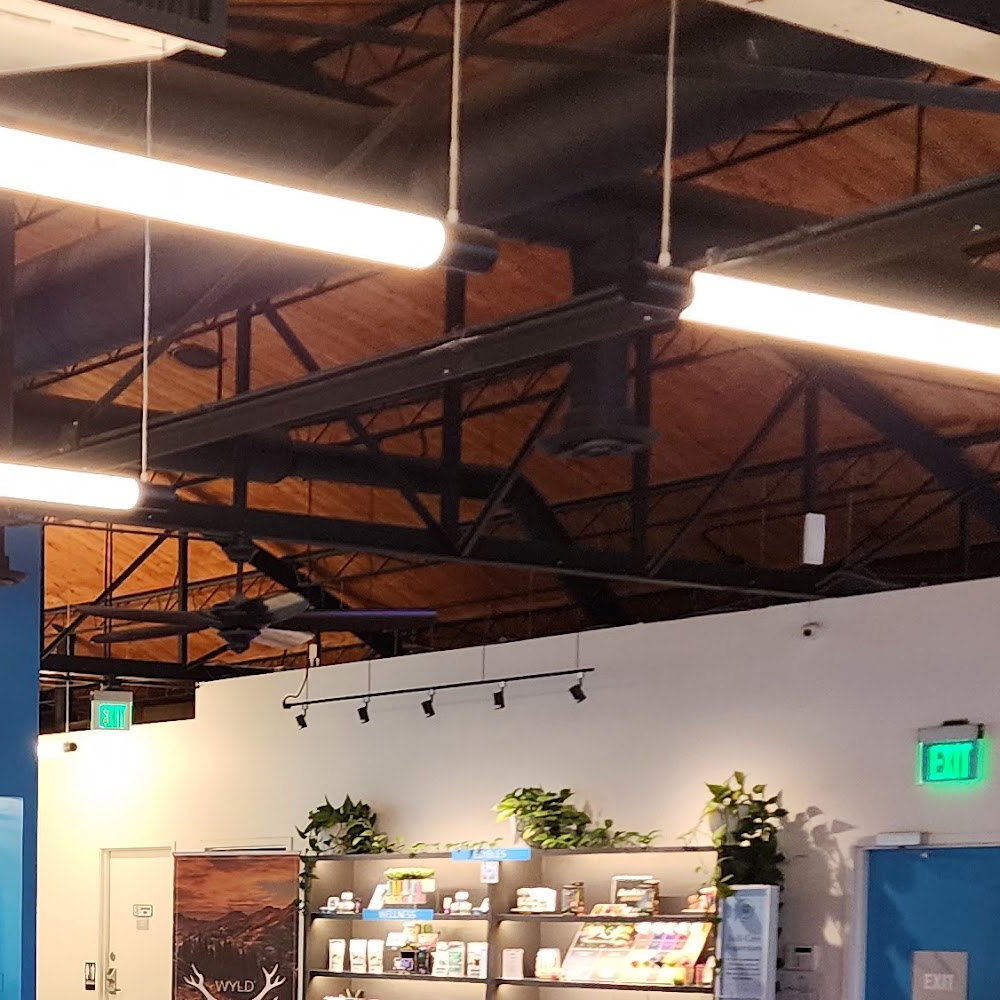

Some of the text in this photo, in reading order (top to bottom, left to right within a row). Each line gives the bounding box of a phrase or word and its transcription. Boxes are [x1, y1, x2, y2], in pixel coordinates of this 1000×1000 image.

[928, 743, 973, 780] EXIT
[379, 908, 416, 919] WELLNESS
[215, 980, 255, 992] WYLD
[924, 974, 954, 991] EXIT
